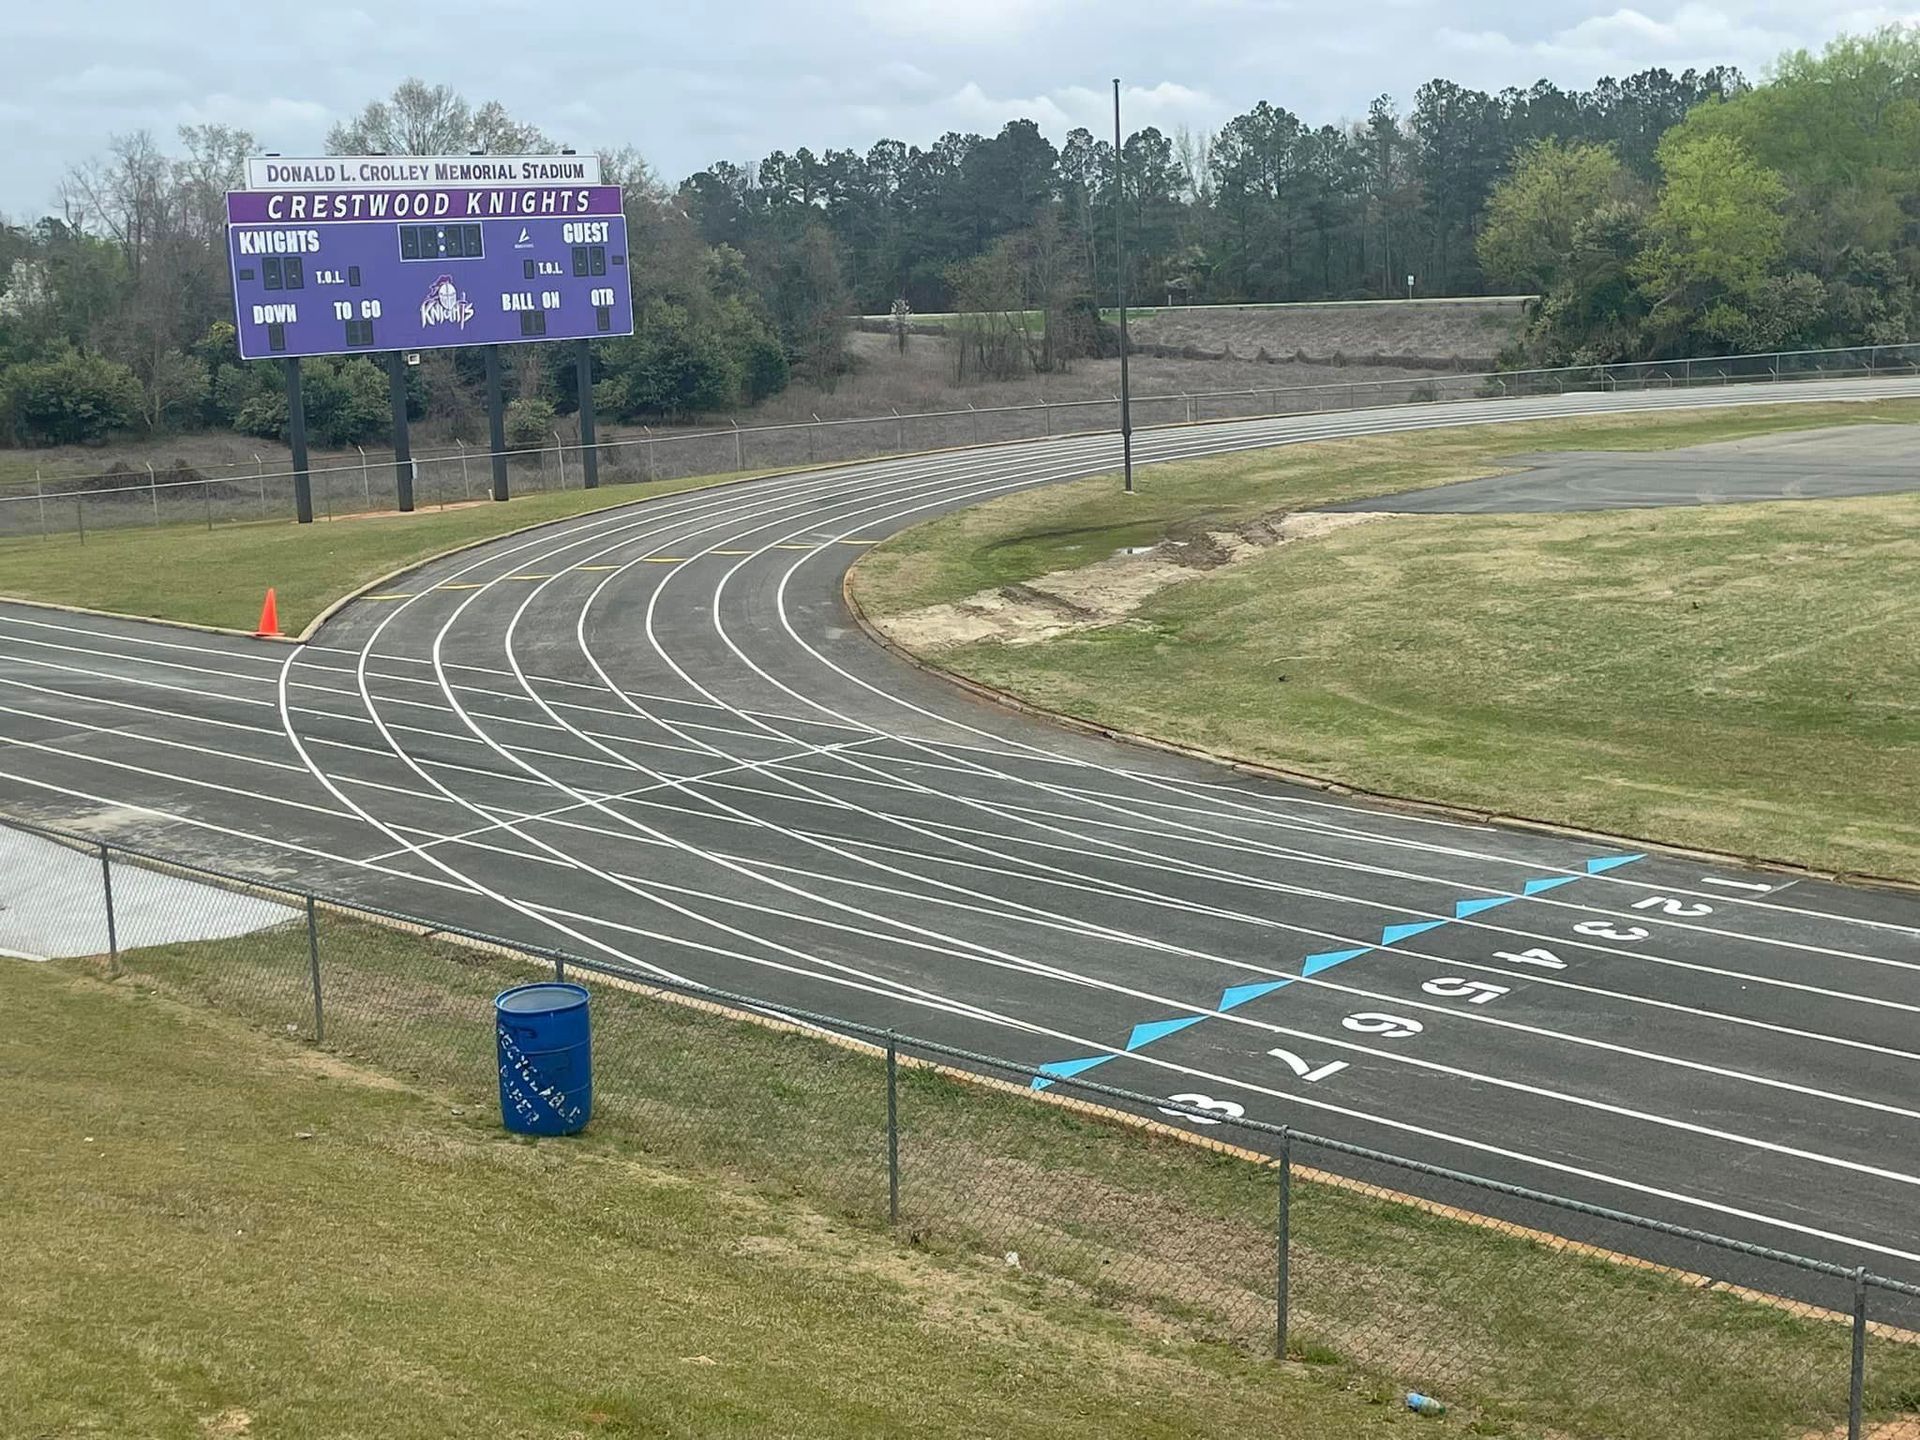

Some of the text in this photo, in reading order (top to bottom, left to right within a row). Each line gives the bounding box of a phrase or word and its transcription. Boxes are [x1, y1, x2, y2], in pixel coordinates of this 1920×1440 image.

[266, 162, 584, 182] DONALD L. CROLLEY MEMORIAL STADIUM
[267, 190, 590, 219] CRESTWOOD KNIGHTS
[239, 230, 320, 254] KNIGHTS
[563, 222, 609, 243] GUEST
[315, 270, 345, 284] T.O.L.
[538, 262, 563, 275] T.O.L.
[501, 291, 560, 311] BALL ON
[590, 288, 615, 306] QTR
[252, 304, 297, 324] DOWN
[334, 300, 381, 320] TO GO
[1701, 877, 1773, 894] 1
[1631, 895, 1715, 917] 2
[1572, 920, 1651, 943] 3
[1493, 945, 1568, 971] 4
[1421, 976, 1512, 1006] 5
[1341, 1011, 1424, 1039] 6
[1267, 1048, 1350, 1082] 7
[1157, 1093, 1246, 1125] 8
